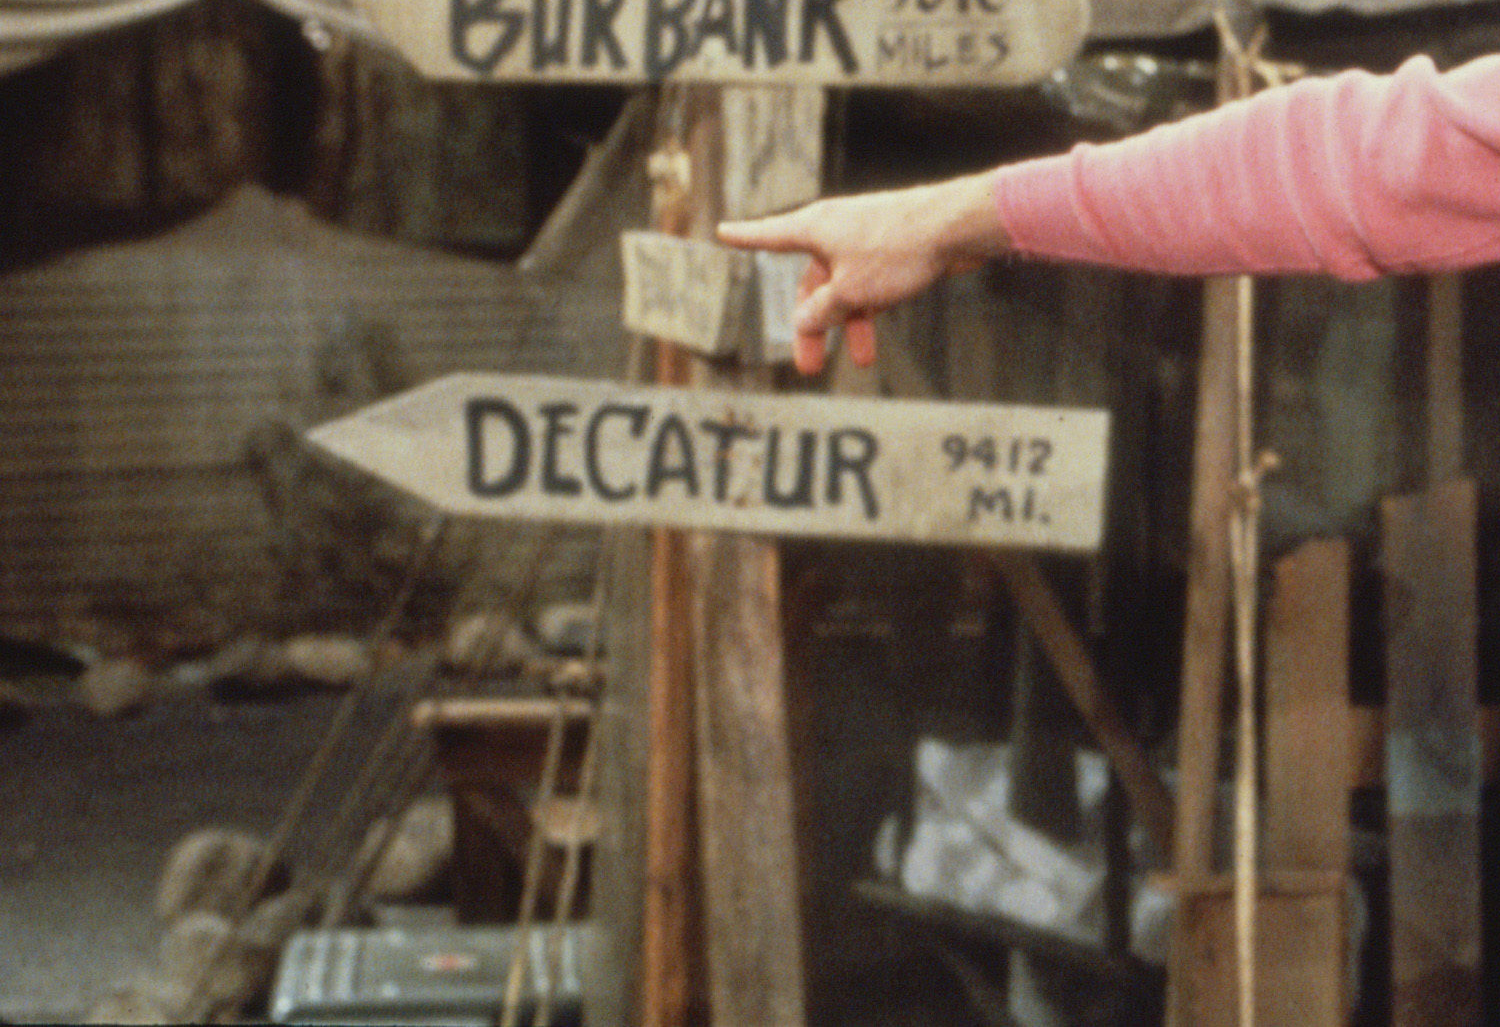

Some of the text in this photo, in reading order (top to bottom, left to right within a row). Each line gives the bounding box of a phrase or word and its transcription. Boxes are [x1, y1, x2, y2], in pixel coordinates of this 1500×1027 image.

[876, 31, 1012, 72] MILES
[464, 397, 880, 522] DECATUR
[941, 432, 1055, 474] 9412
